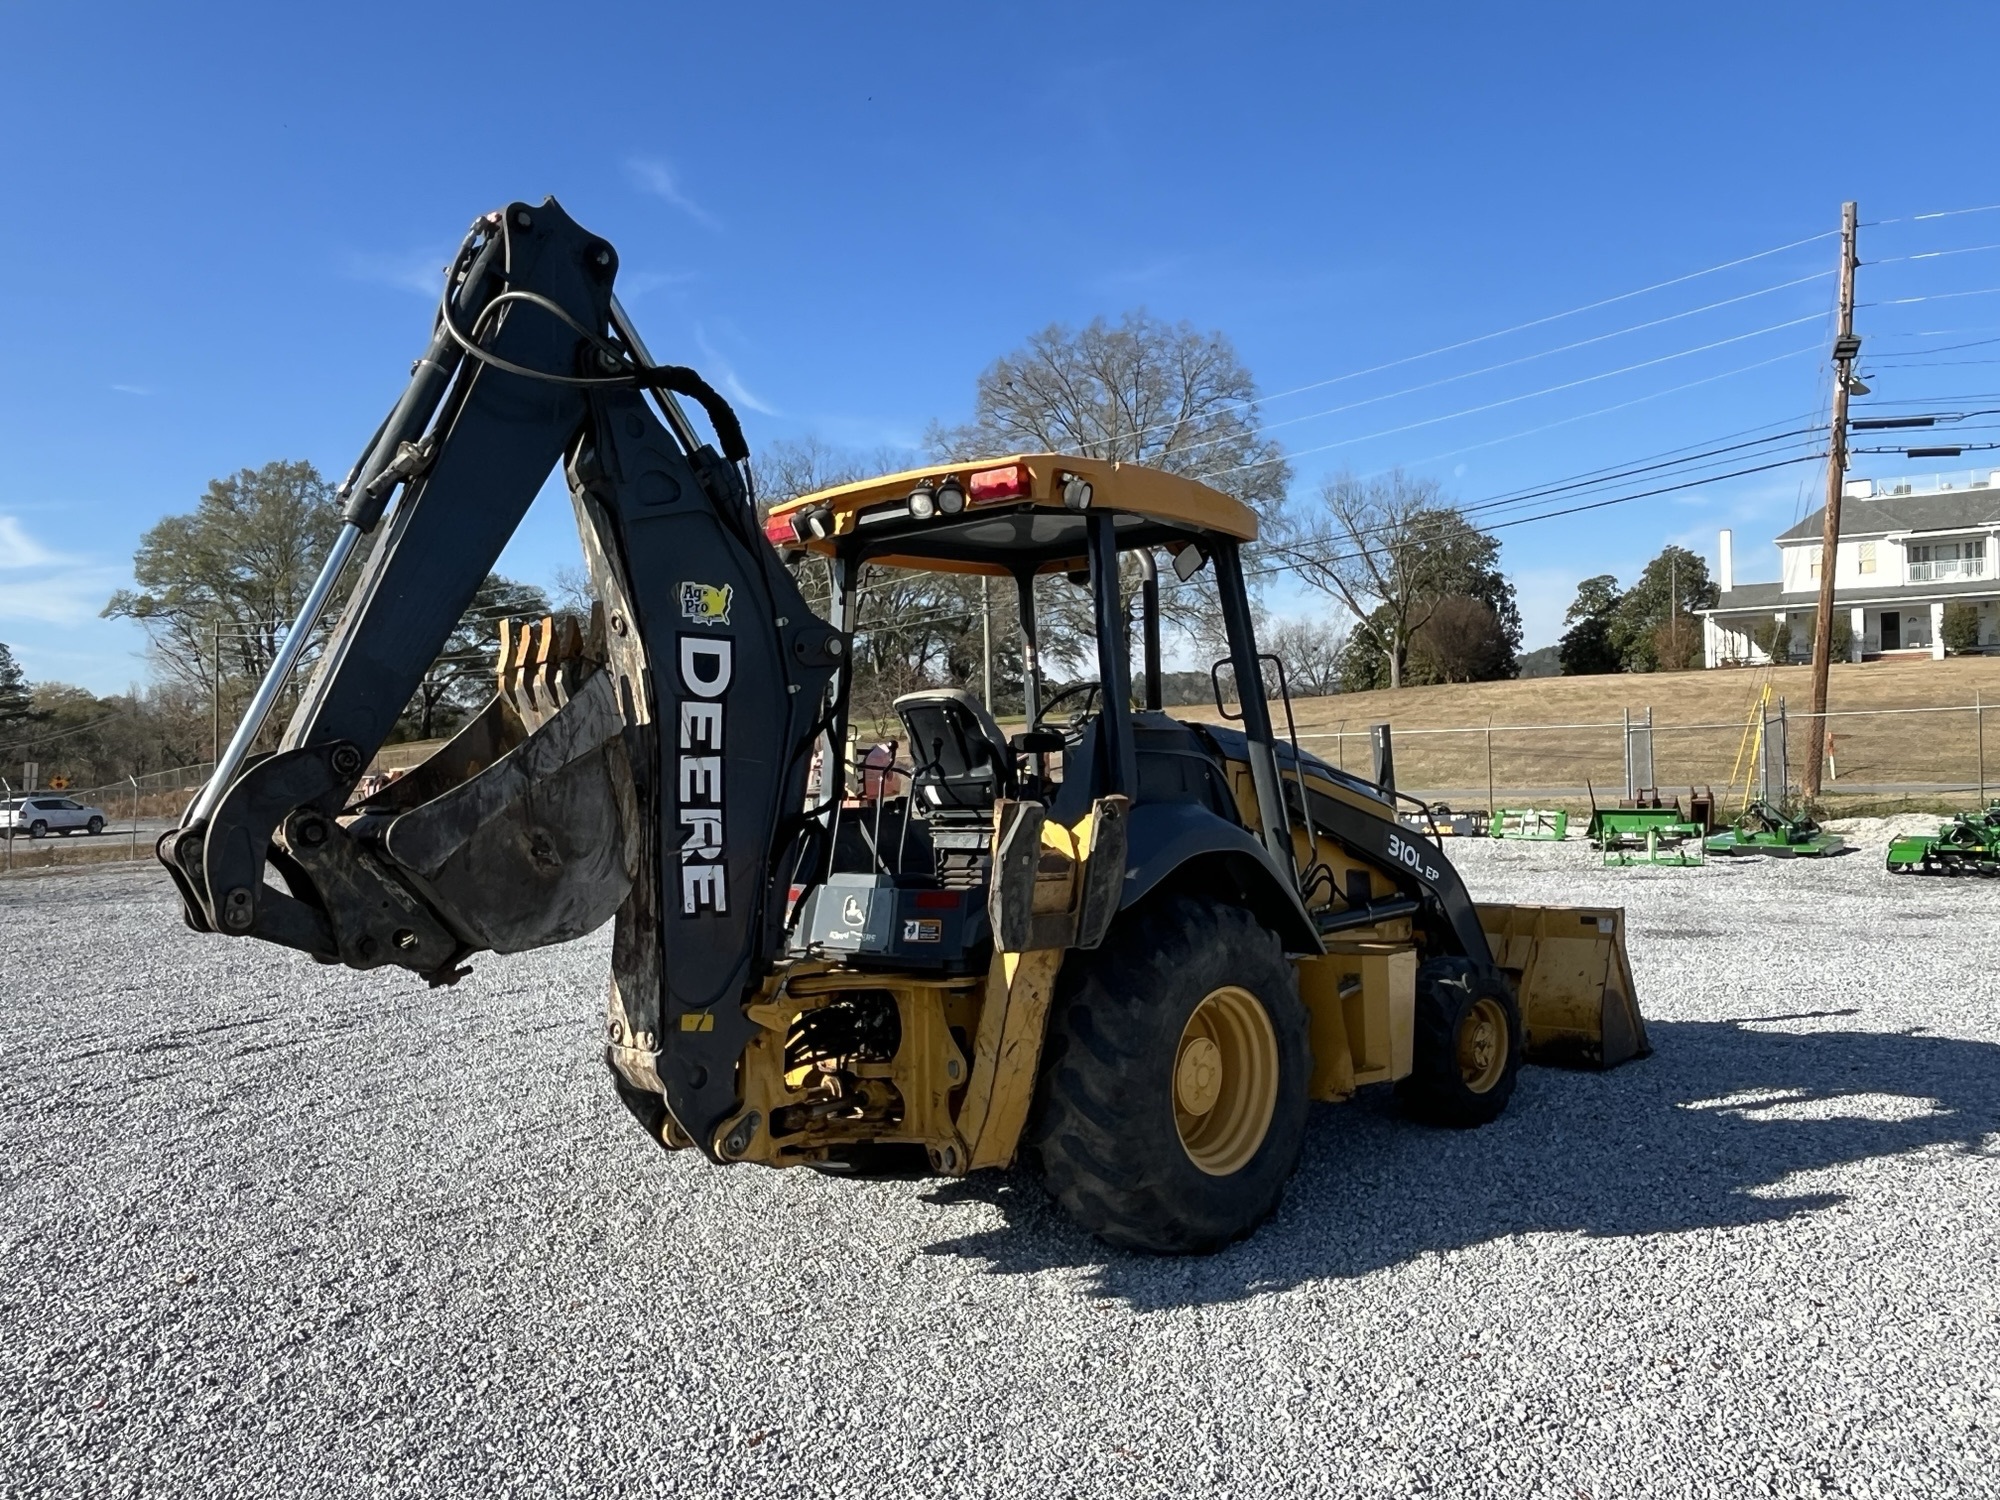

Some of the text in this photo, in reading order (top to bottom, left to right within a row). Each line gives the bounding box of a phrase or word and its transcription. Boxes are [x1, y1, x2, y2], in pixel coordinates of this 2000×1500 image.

[685, 600, 709, 613] Pro
[680, 637, 733, 914] DEERE
[1388, 834, 1440, 881] 310L EP
